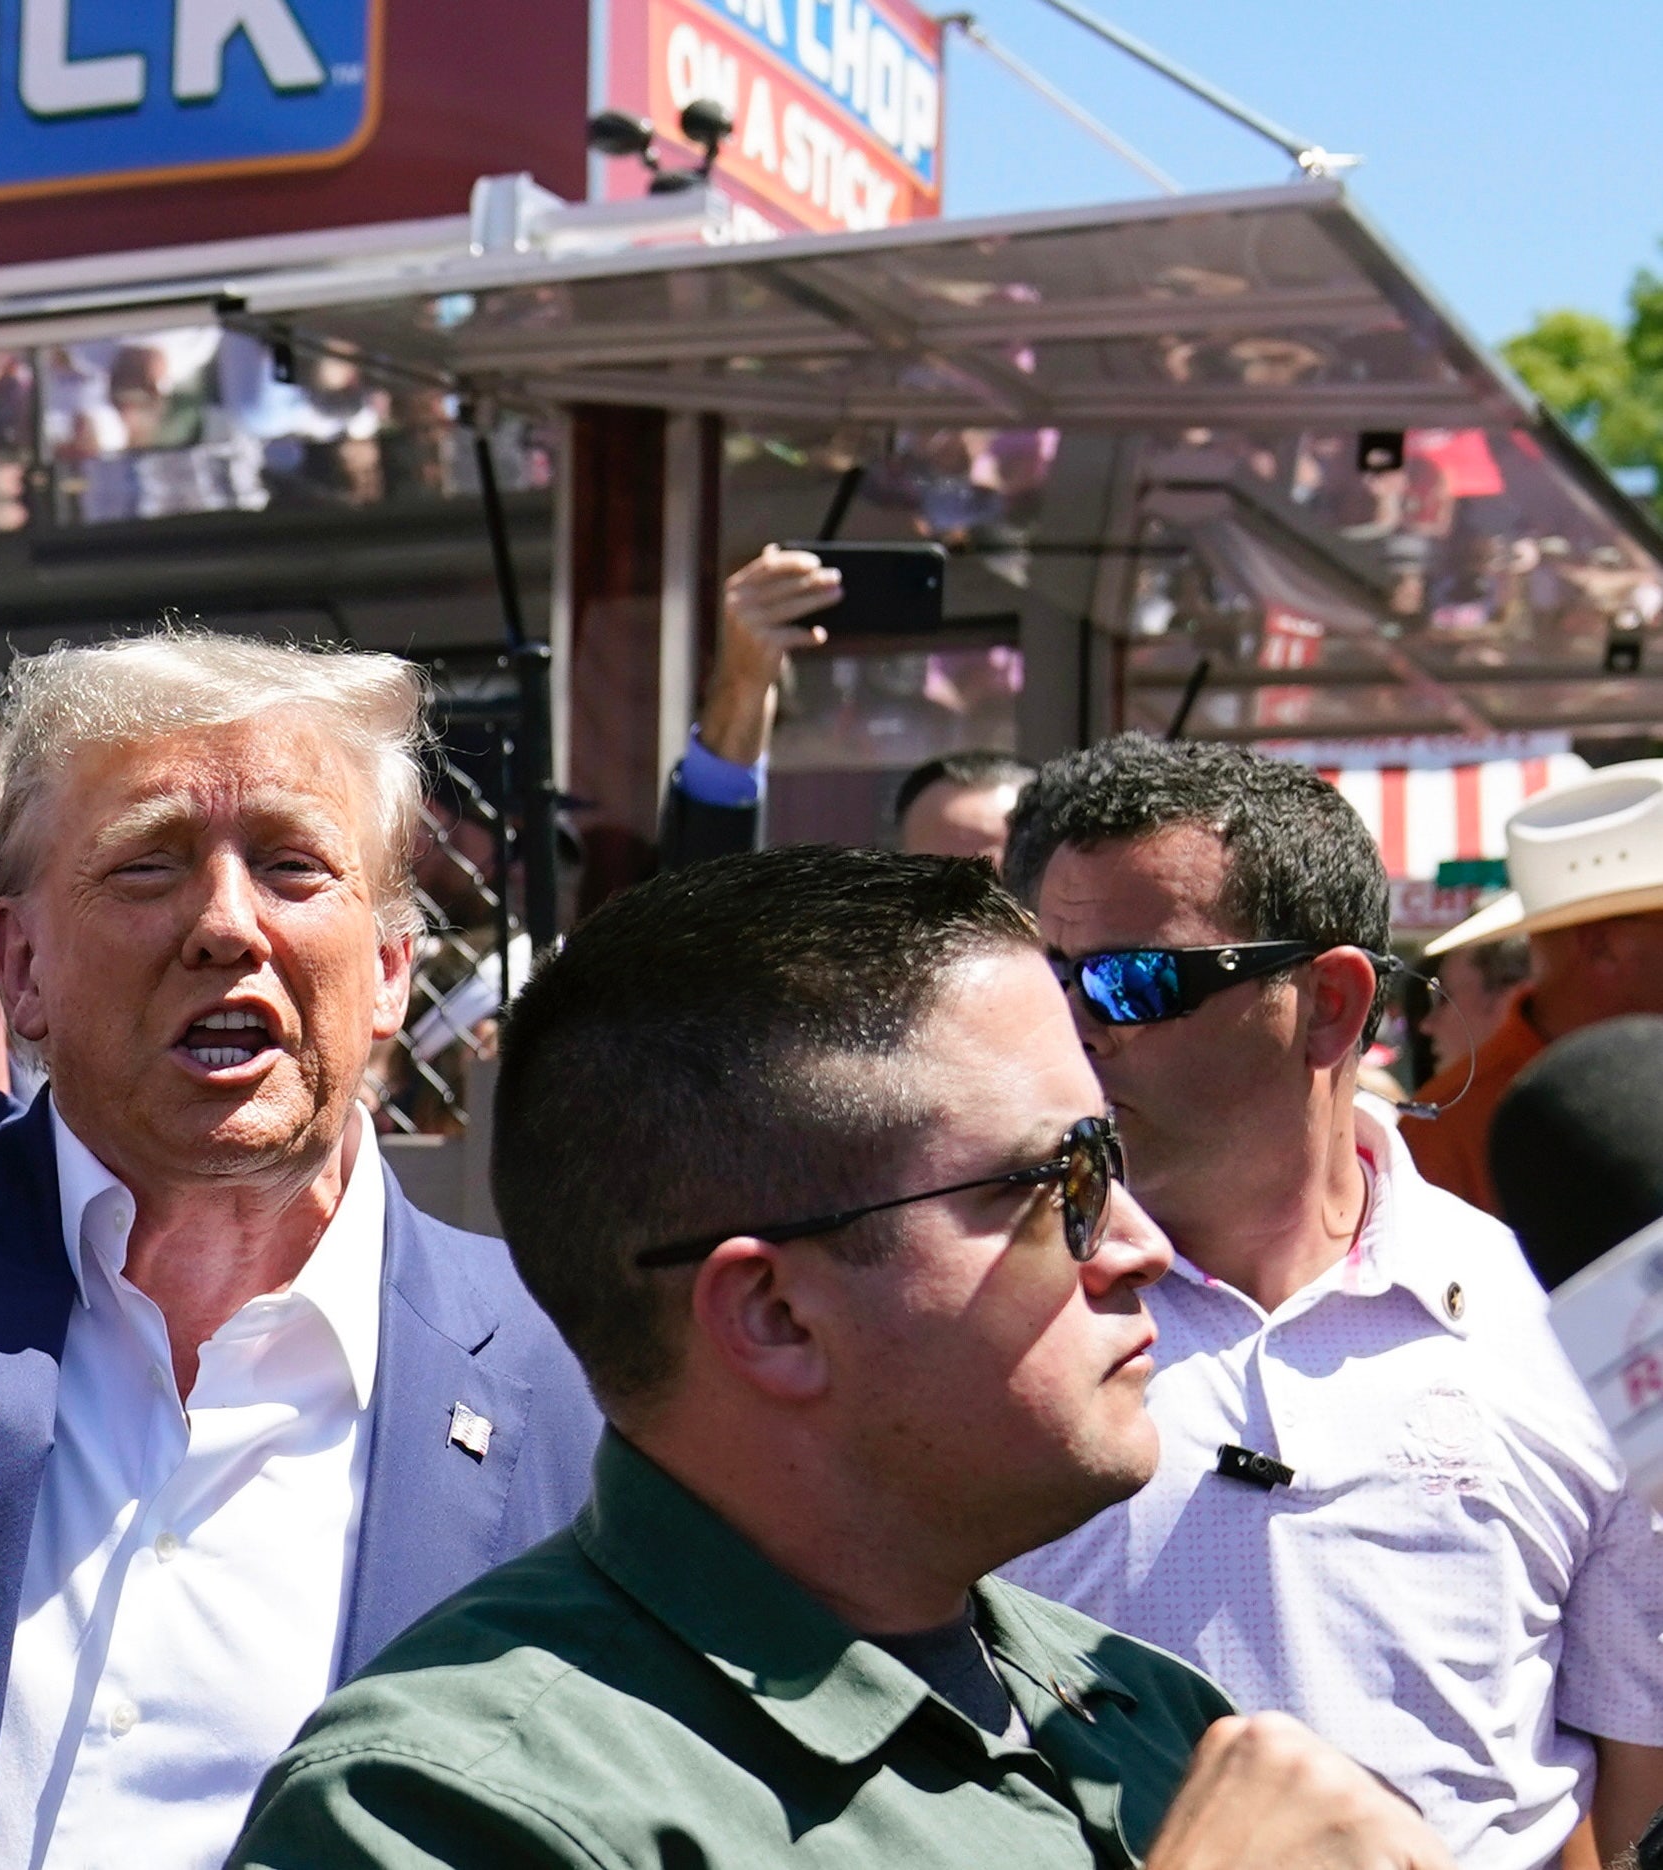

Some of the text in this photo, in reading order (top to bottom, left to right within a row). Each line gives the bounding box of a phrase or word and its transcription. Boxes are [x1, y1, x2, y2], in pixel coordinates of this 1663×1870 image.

[666, 23, 738, 122] ON
[741, 75, 778, 174] A
[782, 101, 897, 233] STICK
[796, 0, 937, 166] CHOP
